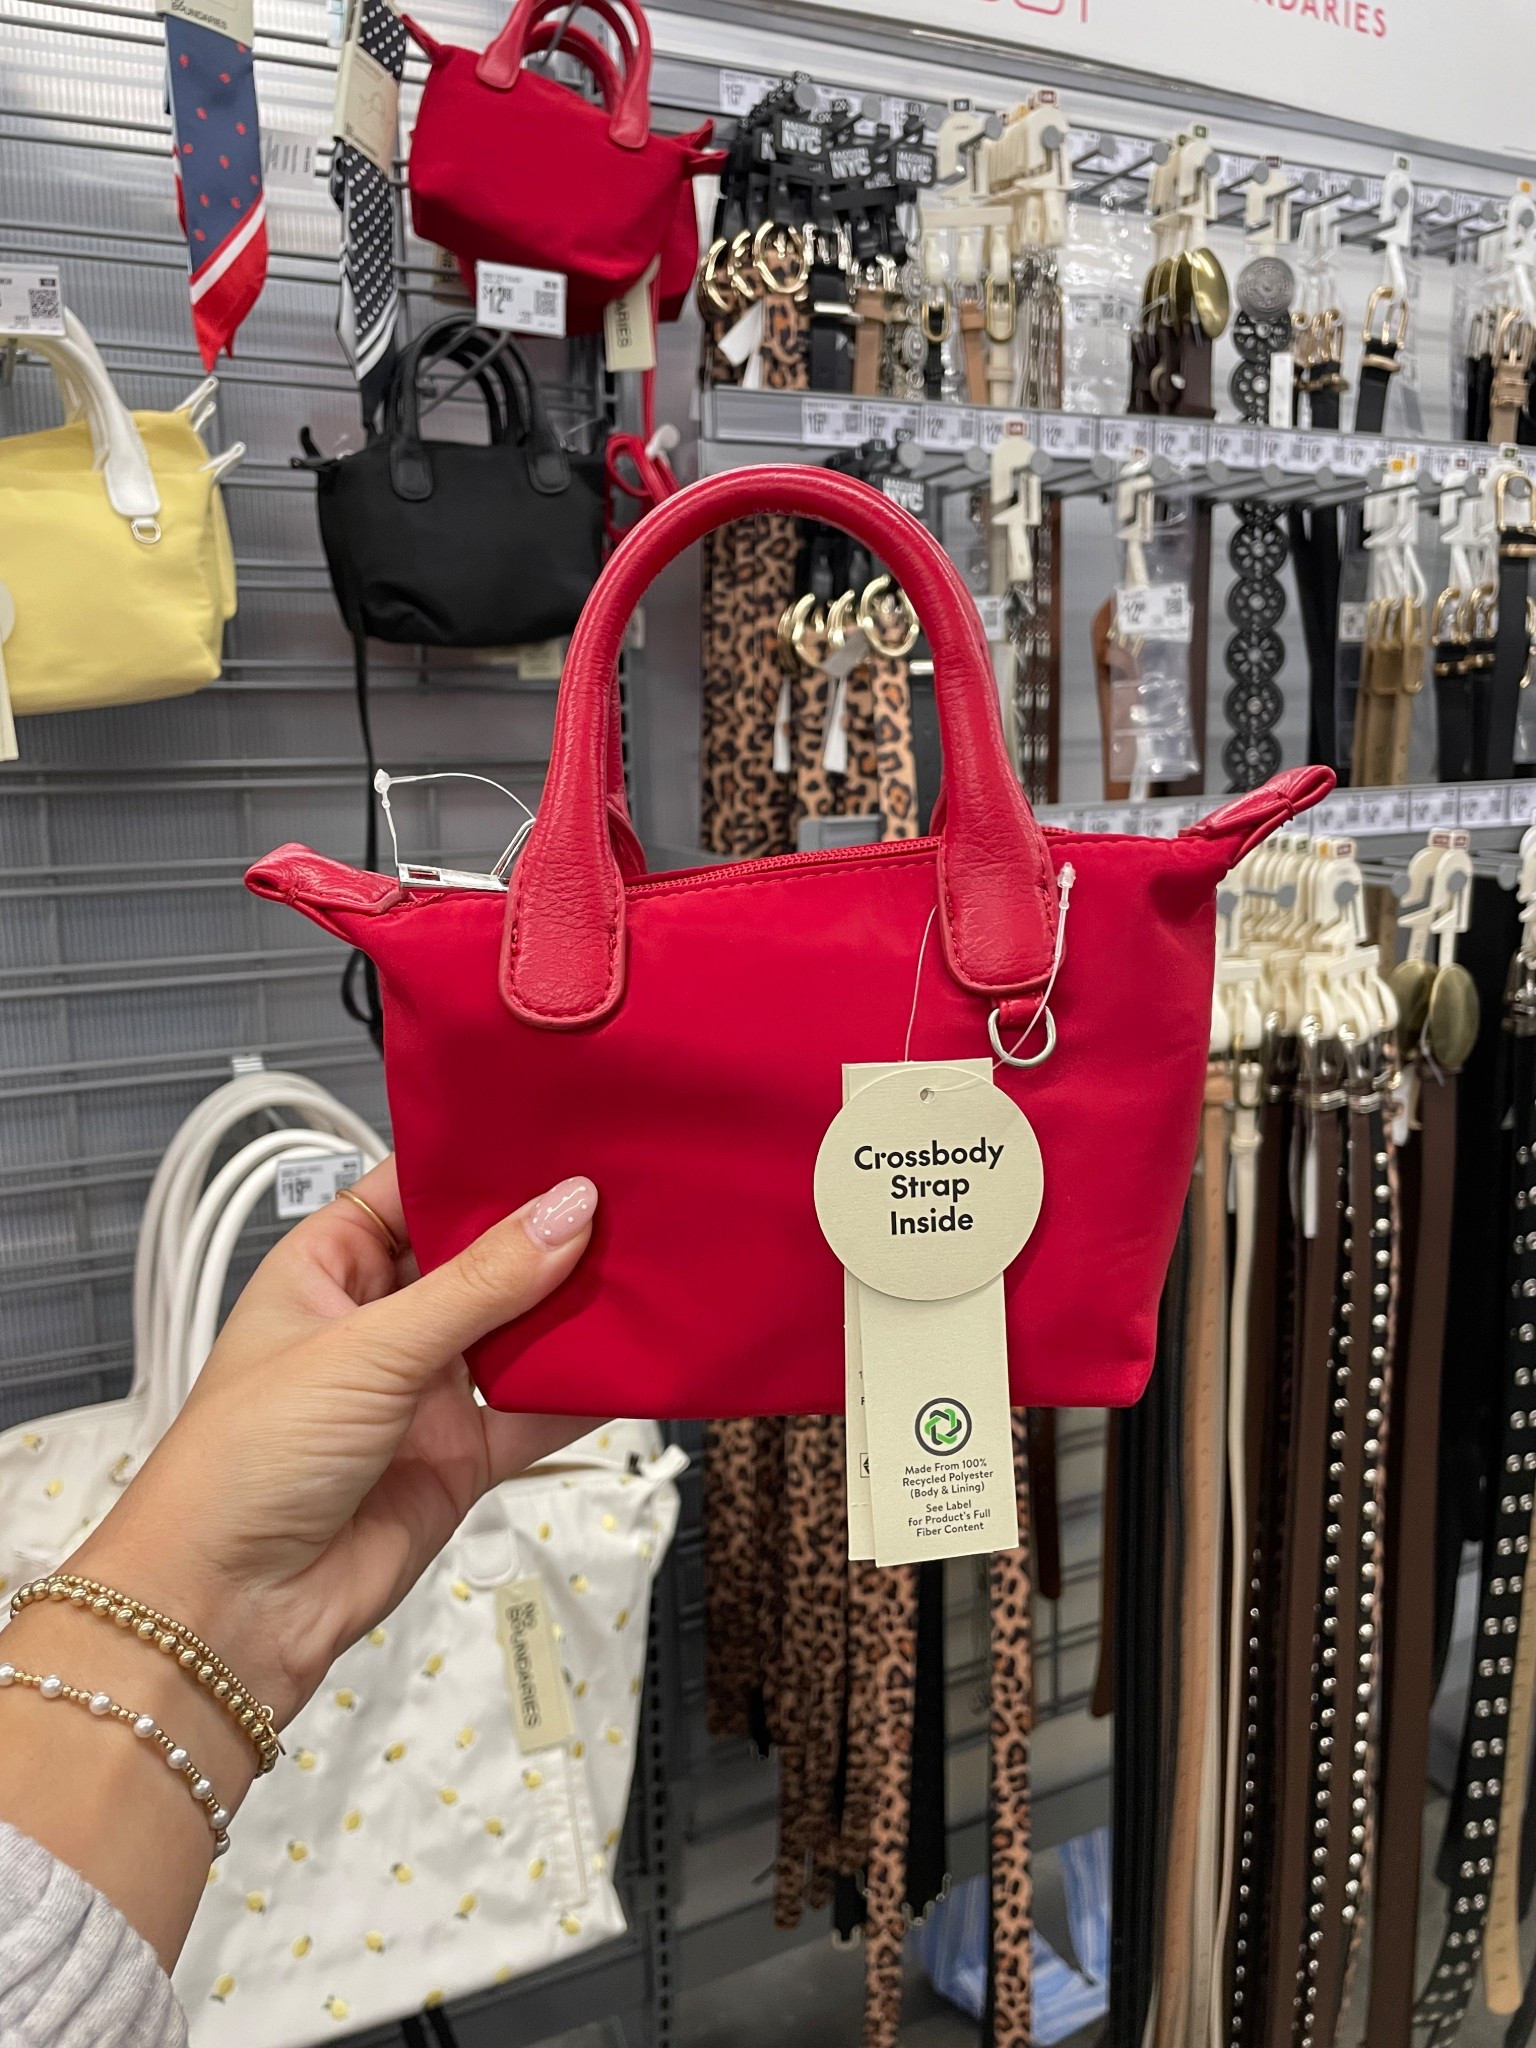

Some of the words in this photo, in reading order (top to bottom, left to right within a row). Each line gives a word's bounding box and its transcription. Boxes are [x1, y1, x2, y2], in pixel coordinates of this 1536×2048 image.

[781, 130, 822, 155] NYC
[831, 157, 871, 179] NYC
[896, 162, 932, 184] NYC
[854, 1137, 1004, 1170] Crossbody
[891, 1174, 970, 1203] Strap
[891, 1206, 974, 1235] Inside
[905, 1465, 932, 1475] Made
[934, 1462, 960, 1473] From
[962, 1458, 987, 1469] 100%
[902, 1473, 946, 1487] Recycled
[949, 1470, 994, 1483] Polyester
[910, 1486, 939, 1499] (Body
[941, 1486, 949, 1495] &
[951, 1481, 985, 1494] Lining)
[926, 1504, 944, 1513] See
[946, 1499, 972, 1511] Label
[908, 1517, 923, 1527] for
[925, 1511, 971, 1525] Product's
[973, 1508, 991, 1519] Full
[916, 1527, 942, 1537] Fiber
[944, 1522, 984, 1534] Content
